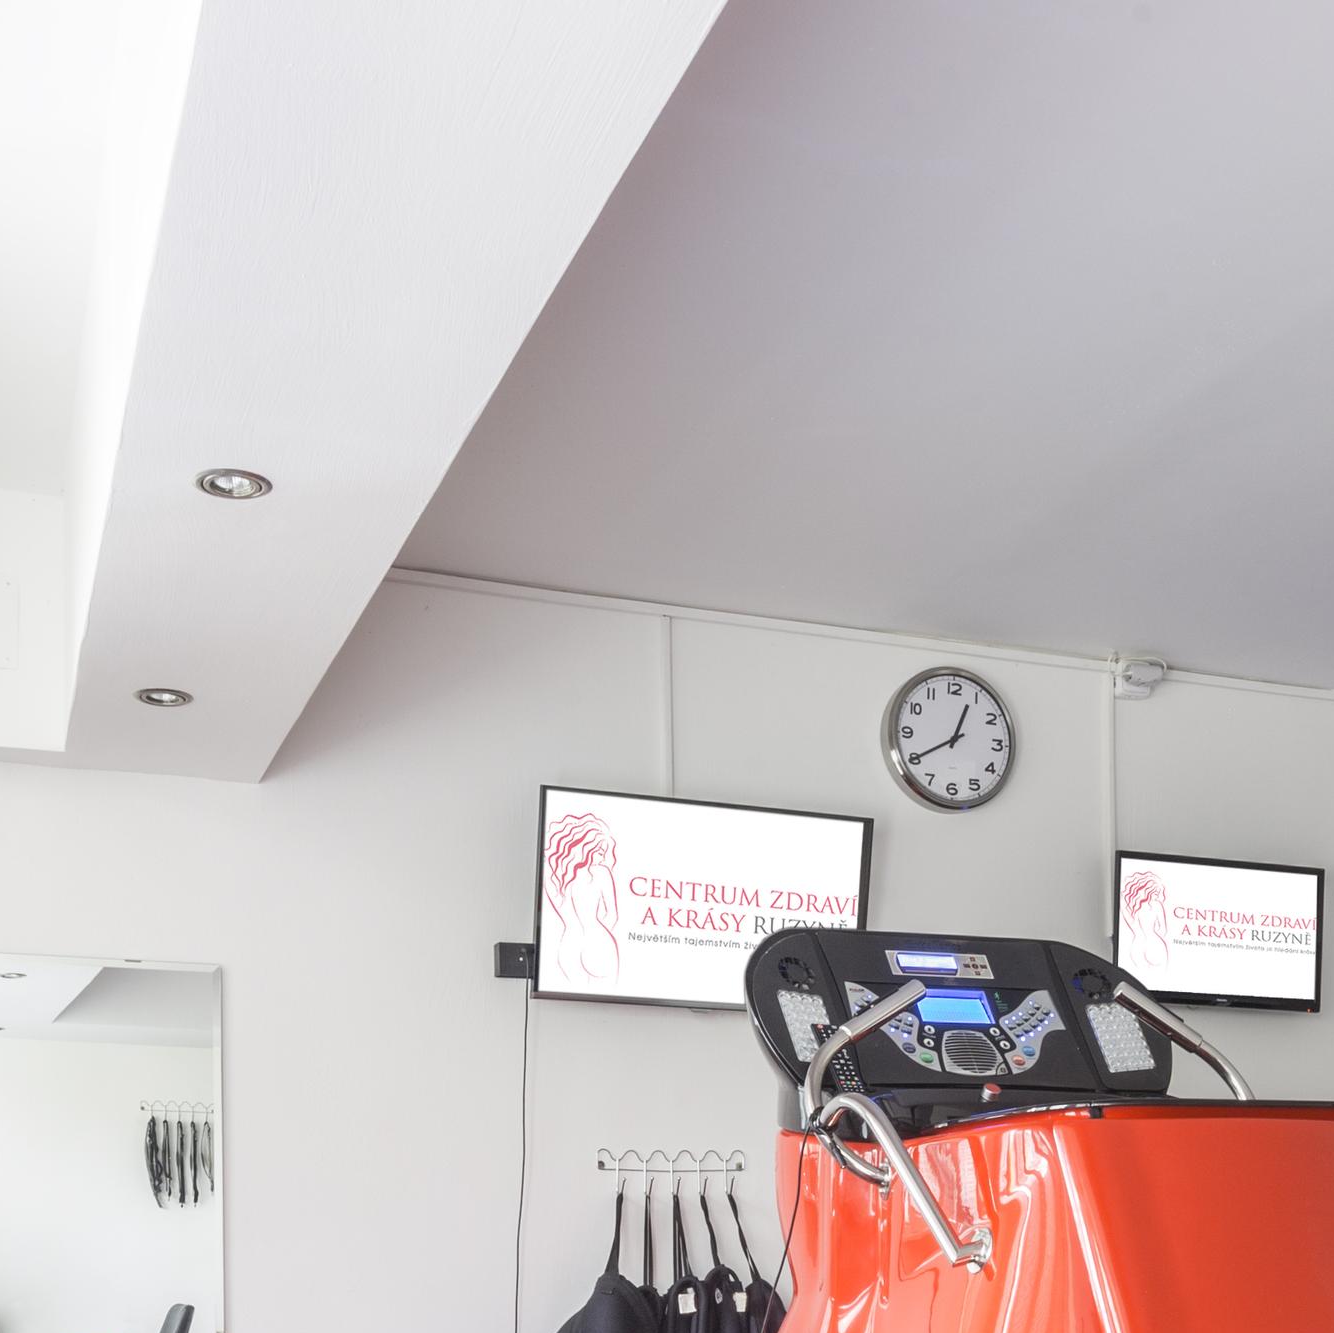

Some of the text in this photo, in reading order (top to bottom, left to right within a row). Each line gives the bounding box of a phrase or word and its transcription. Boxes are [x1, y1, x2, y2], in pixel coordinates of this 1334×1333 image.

[926, 687, 935, 700] 11
[947, 682, 962, 696] 12
[974, 691, 978, 704] 1
[910, 702, 922, 715] 10
[985, 713, 997, 725] 2
[901, 726, 914, 738] 9
[991, 739, 1003, 752] 3
[908, 752, 921, 765] 8
[985, 762, 996, 774] 4
[924, 773, 935, 786] 7
[969, 779, 981, 791] 5
[946, 783, 958, 795] 6
[629, 876, 858, 917] CENTRUM ZDRAVÍ
[640, 906, 657, 926] A
[667, 907, 746, 932] KRÁSY
[1173, 906, 1316, 930] CENTRUM ZDRAVÍ
[1181, 924, 1312, 946] A KRÁSY RUZYNĚ
[684, 937, 741, 950] tajemstvím
